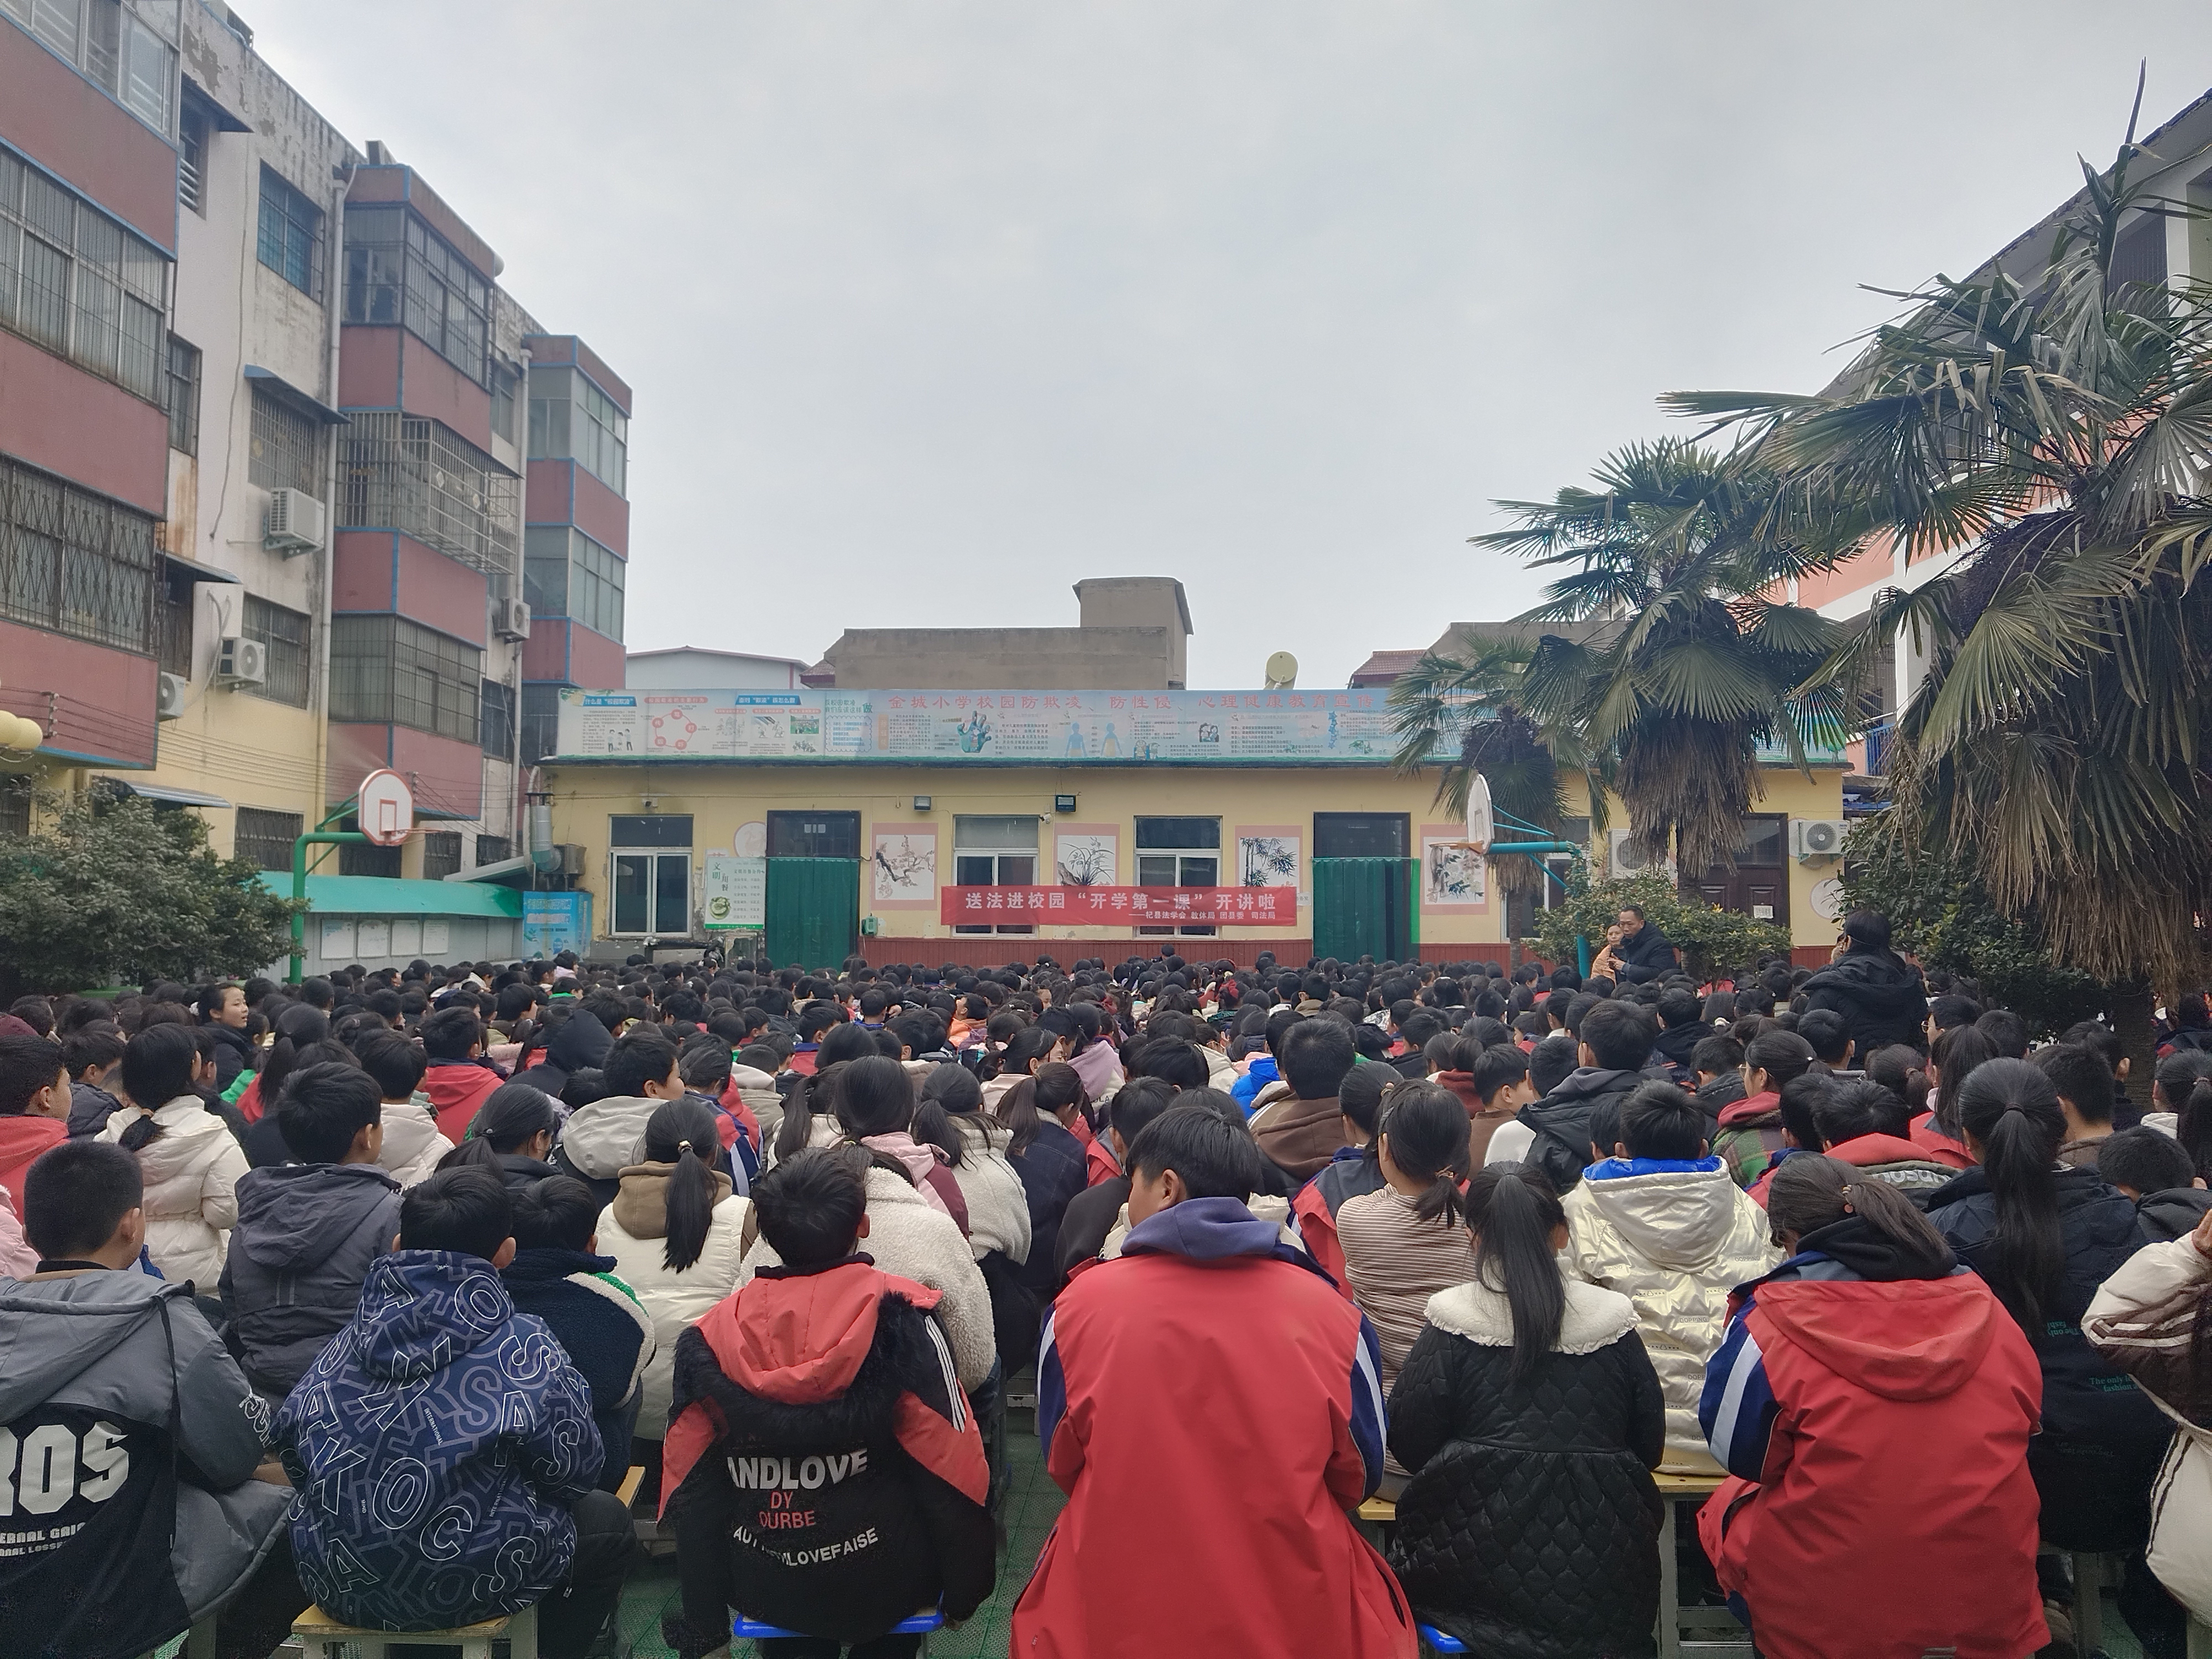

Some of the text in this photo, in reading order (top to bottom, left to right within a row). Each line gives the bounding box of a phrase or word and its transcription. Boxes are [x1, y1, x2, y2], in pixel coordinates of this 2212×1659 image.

[1191, 911, 1215, 919] 教体局
[1220, 911, 1244, 919] 团县委
[1251, 911, 1275, 919] 司法局
[2107, 1376, 2123, 1384] only
[424, 1407, 444, 1446] INTERNATIONAL
